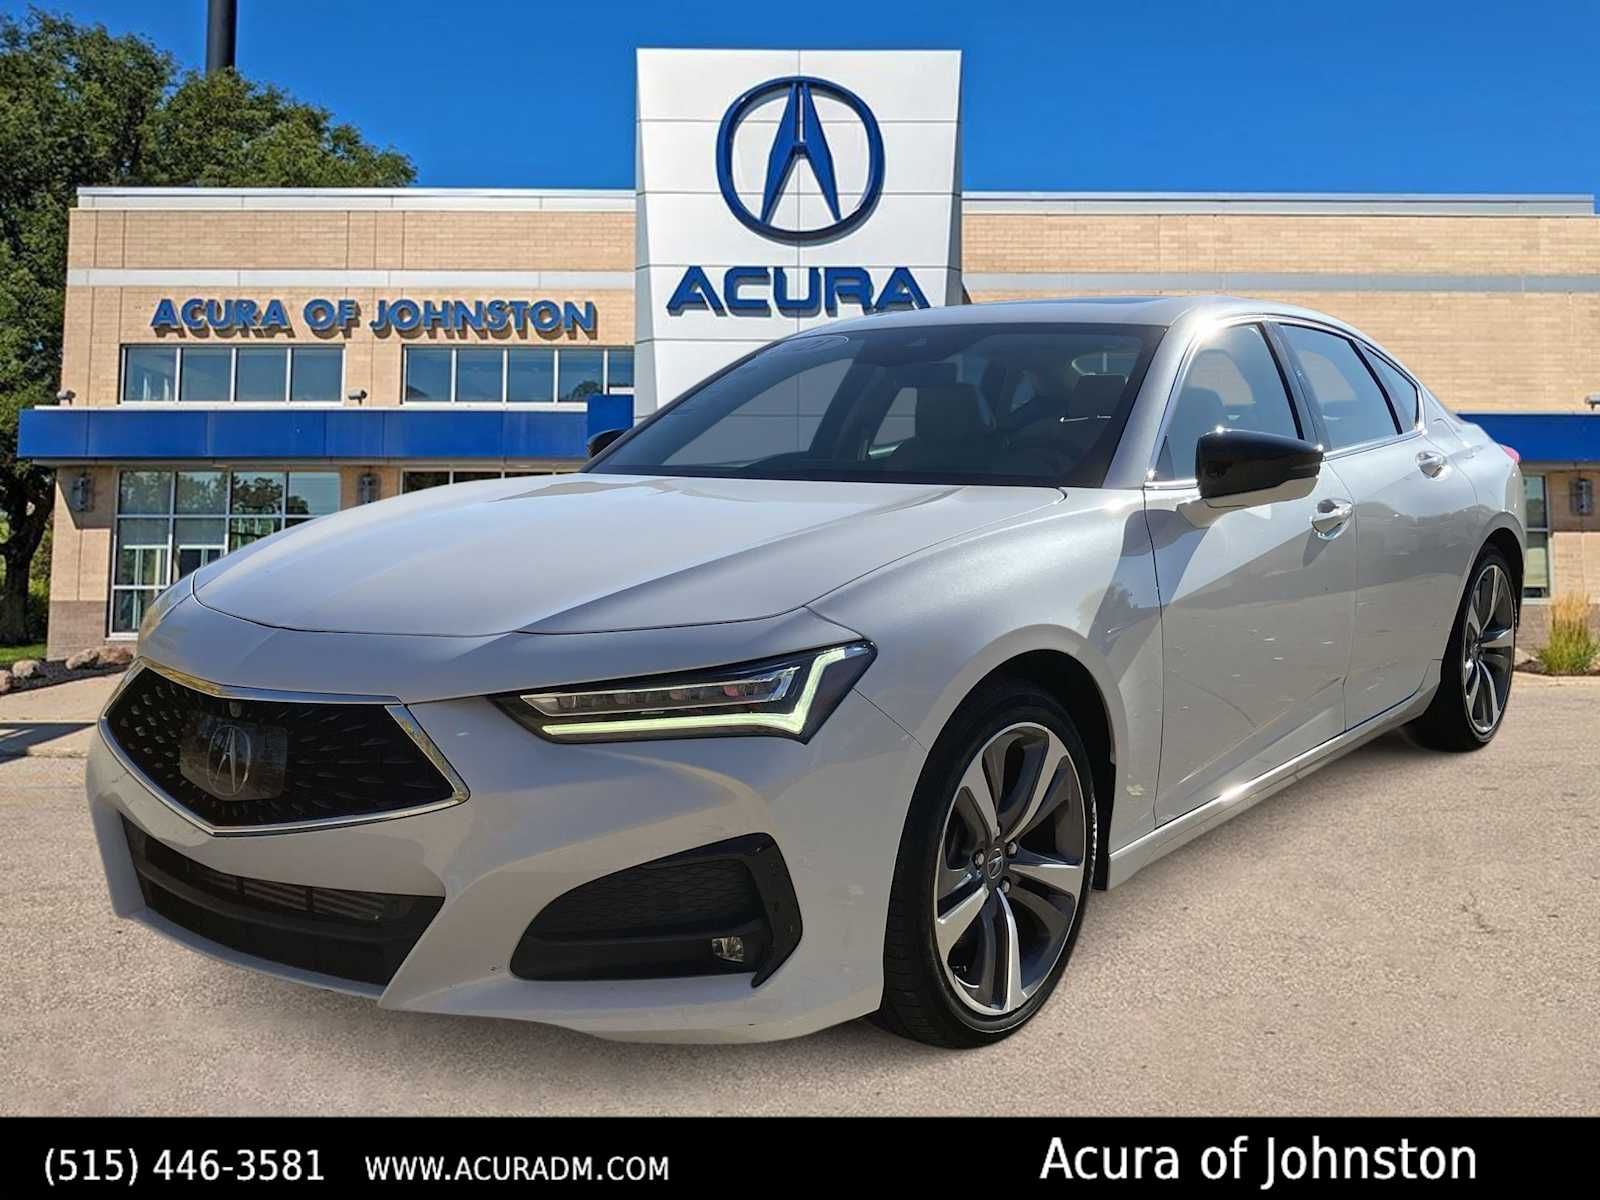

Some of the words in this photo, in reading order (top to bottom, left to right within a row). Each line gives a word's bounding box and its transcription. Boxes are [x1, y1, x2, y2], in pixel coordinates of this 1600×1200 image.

[666, 265, 932, 318] ACURA
[150, 298, 293, 333] ACURA
[303, 298, 359, 334] OF
[369, 298, 597, 336] JOHNSTON
